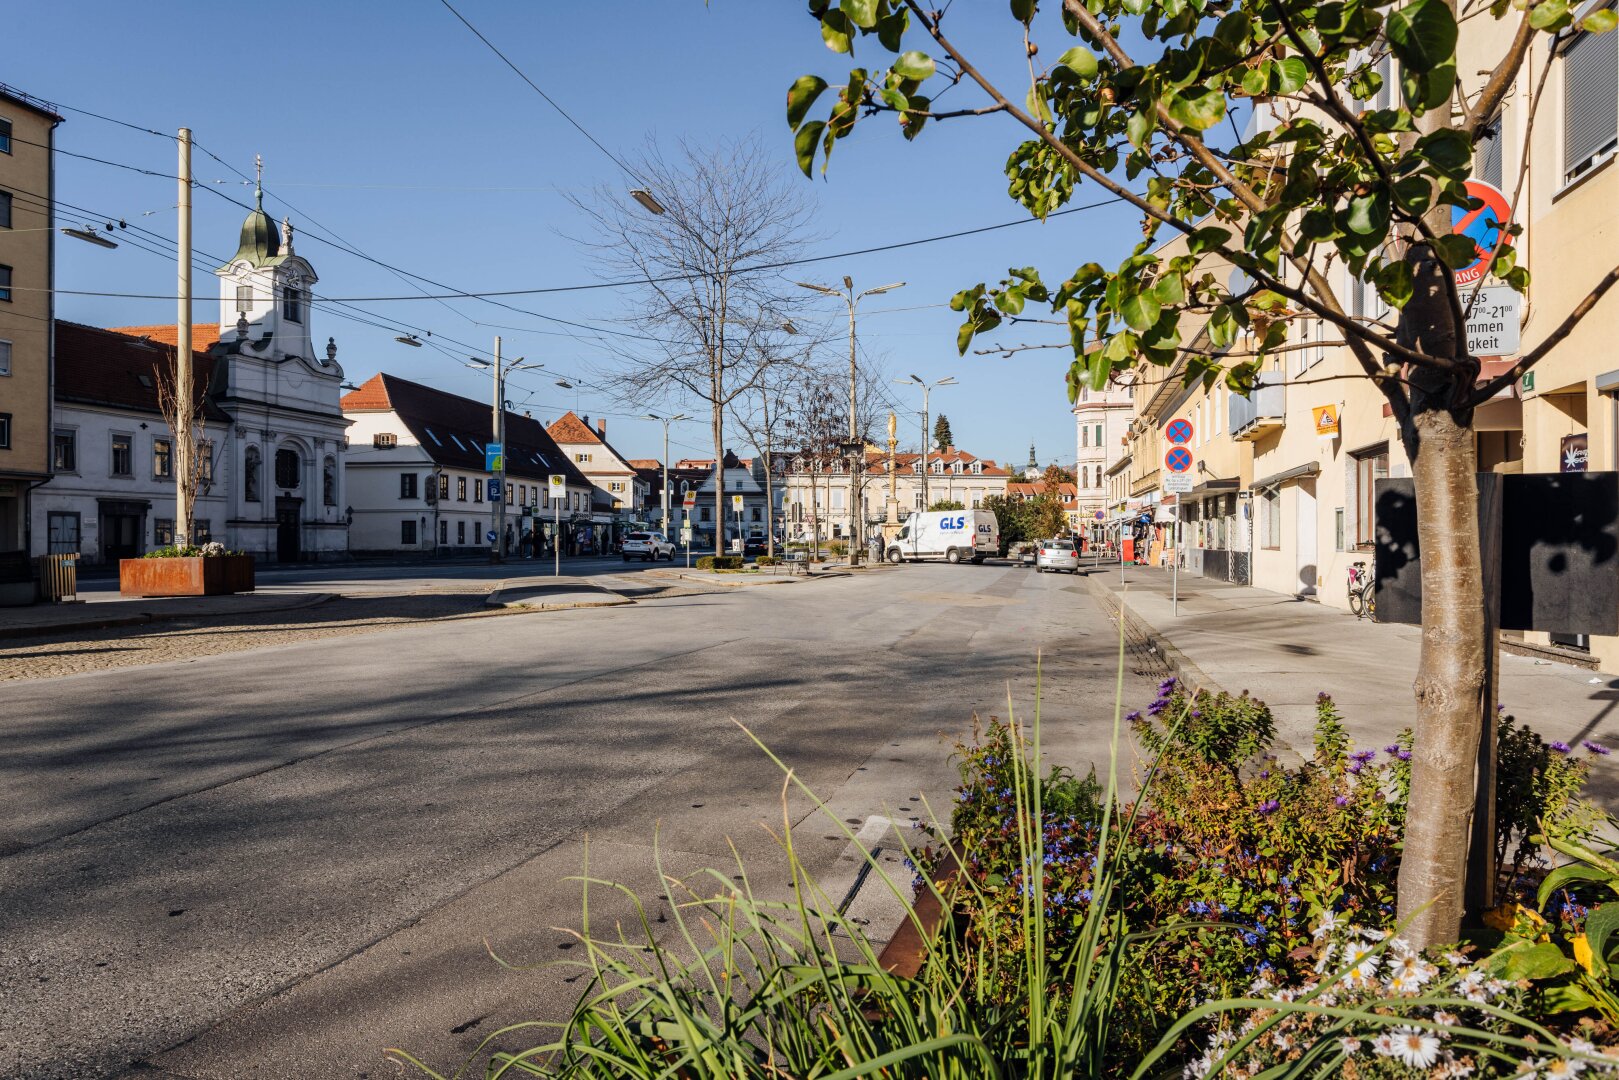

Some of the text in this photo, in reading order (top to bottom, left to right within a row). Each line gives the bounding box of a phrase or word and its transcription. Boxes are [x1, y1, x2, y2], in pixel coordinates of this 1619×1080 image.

[1455, 268, 1480, 283] ANG
[1459, 292, 1488, 306] tags
[1466, 322, 1504, 334] mmen
[1468, 335, 1500, 353] gkeit
[940, 516, 965, 530] GLS
[978, 524, 991, 533] GLS
